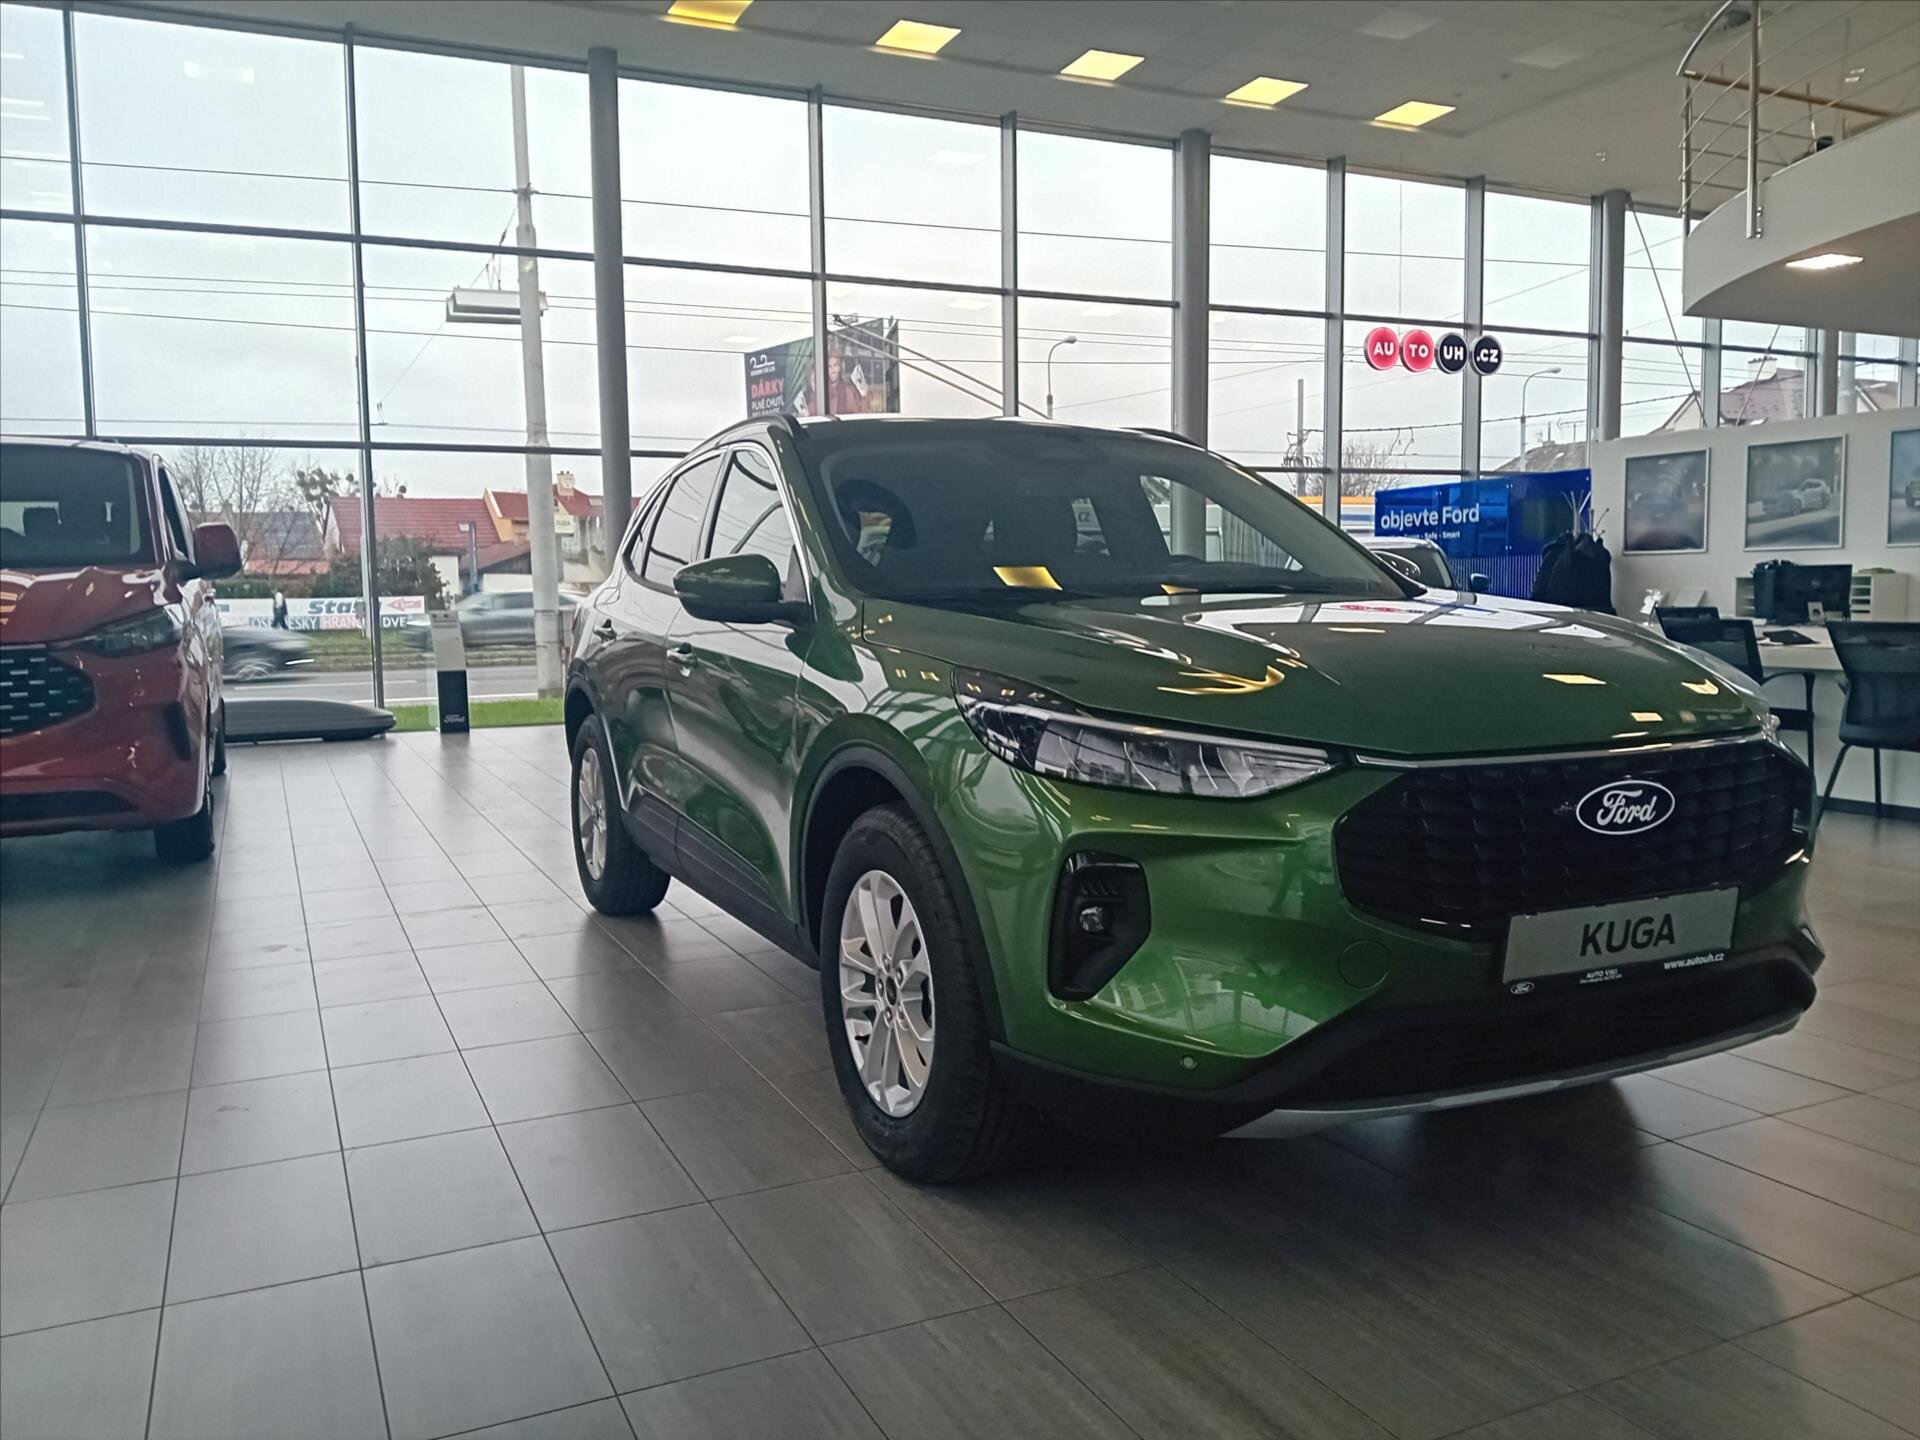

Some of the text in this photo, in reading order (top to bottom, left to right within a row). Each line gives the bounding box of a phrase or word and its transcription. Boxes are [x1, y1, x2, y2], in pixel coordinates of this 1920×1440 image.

[1373, 341, 1395, 356] AU
[1409, 344, 1429, 358] TO
[1443, 345, 1464, 361] UH
[1380, 503, 1480, 530] objevte Ford
[1596, 789, 1658, 826] Ford
[1579, 913, 1677, 957] KUGA
